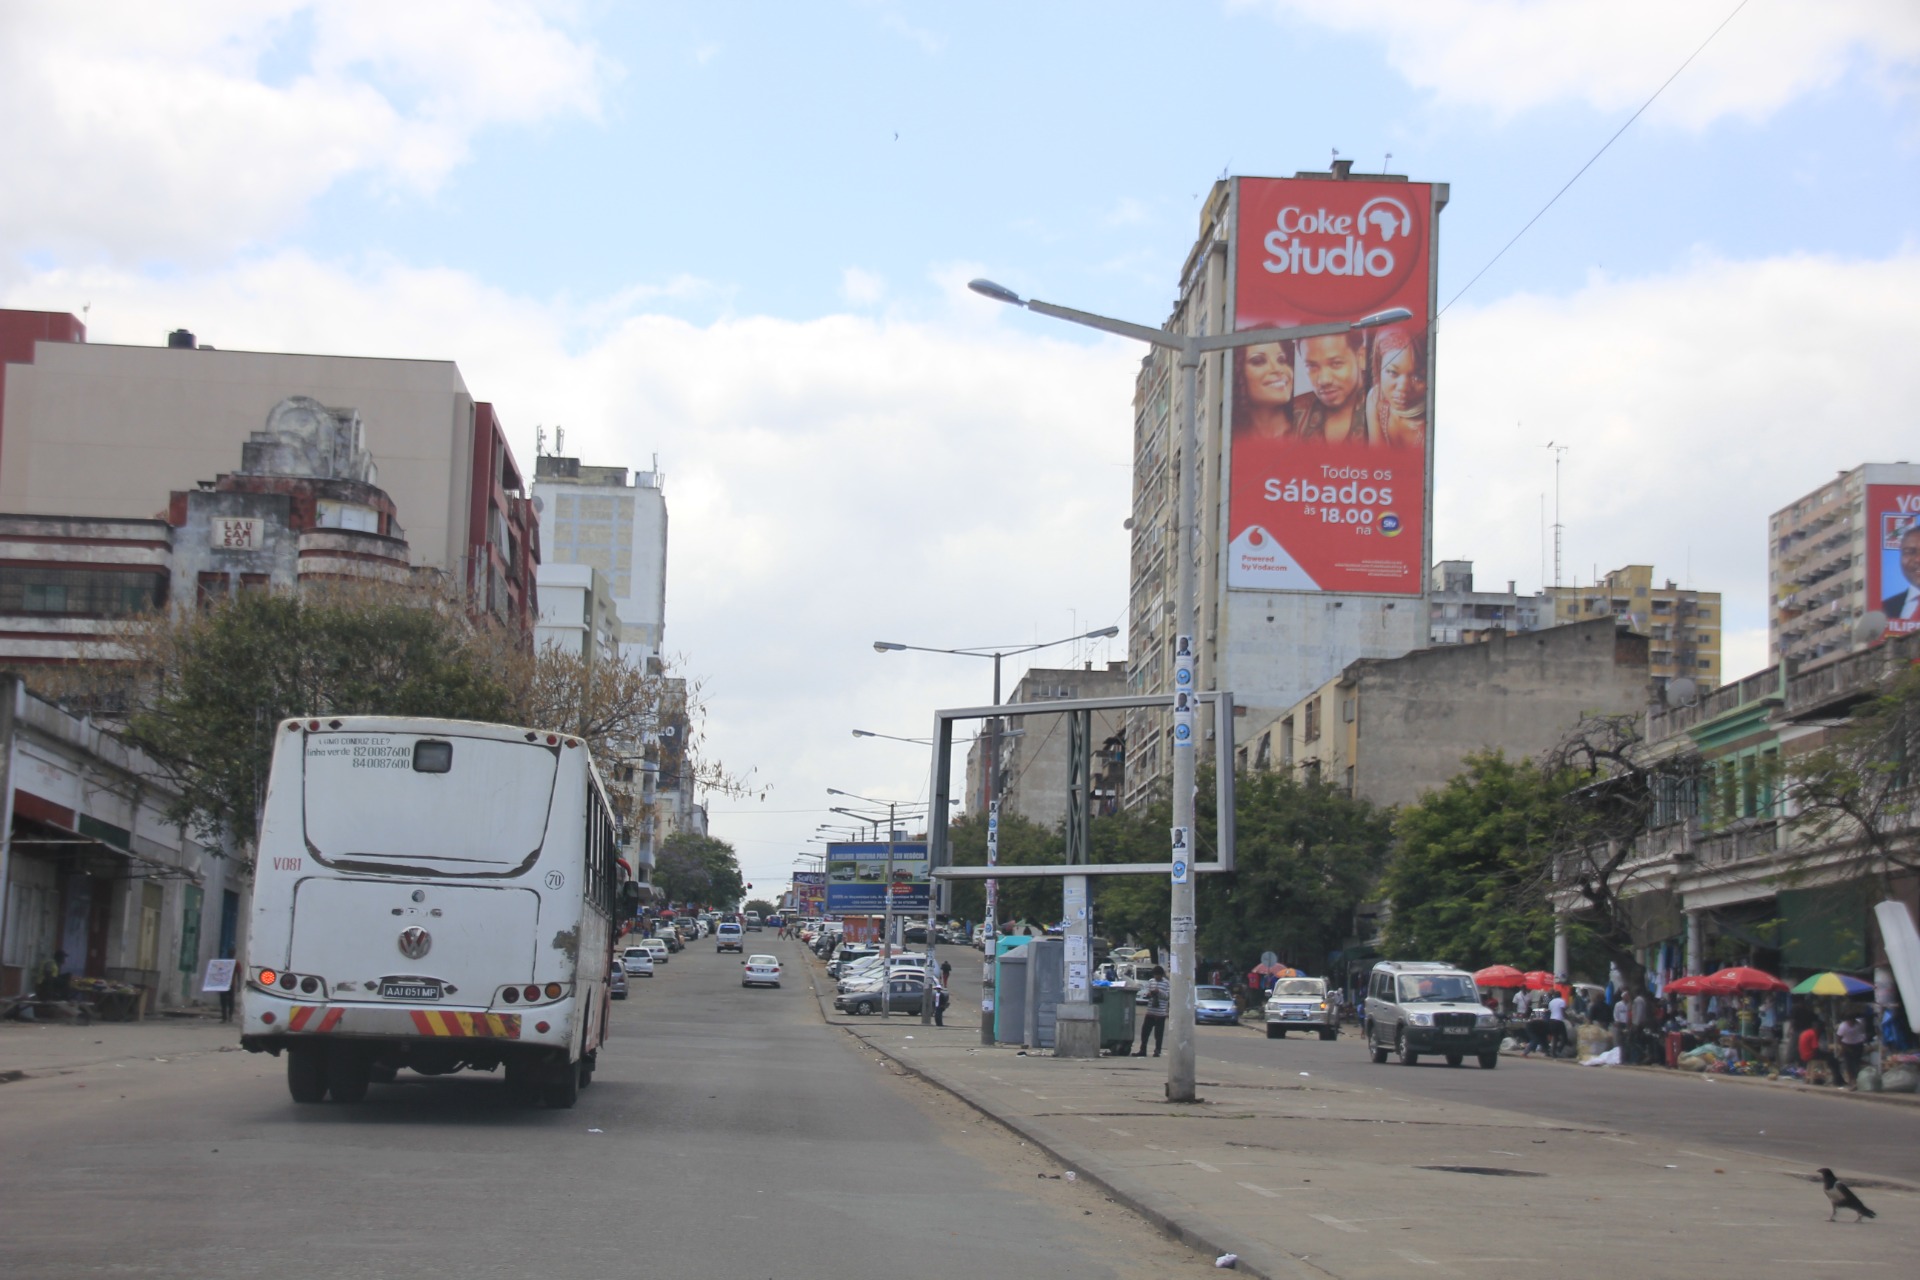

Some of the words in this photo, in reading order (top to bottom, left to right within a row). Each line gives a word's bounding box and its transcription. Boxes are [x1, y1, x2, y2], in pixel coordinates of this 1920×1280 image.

[1277, 207, 1352, 235] Coke
[1263, 231, 1394, 277] Studio
[1320, 465, 1368, 480] Todos
[1373, 469, 1392, 480] os
[1264, 478, 1393, 505] Sábados
[1303, 505, 1316, 515] às
[1320, 507, 1373, 524] 18.00
[224, 521, 253, 530] LAU
[1356, 526, 1372, 535] na
[1241, 554, 1275, 563] Powered
[1241, 563, 1251, 571] by
[1253, 563, 1288, 572] Vodacom
[327, 748, 351, 756] verde
[352, 758, 410, 769] 840087600
[273, 857, 302, 871] V081
[549, 874, 562, 887] 70
